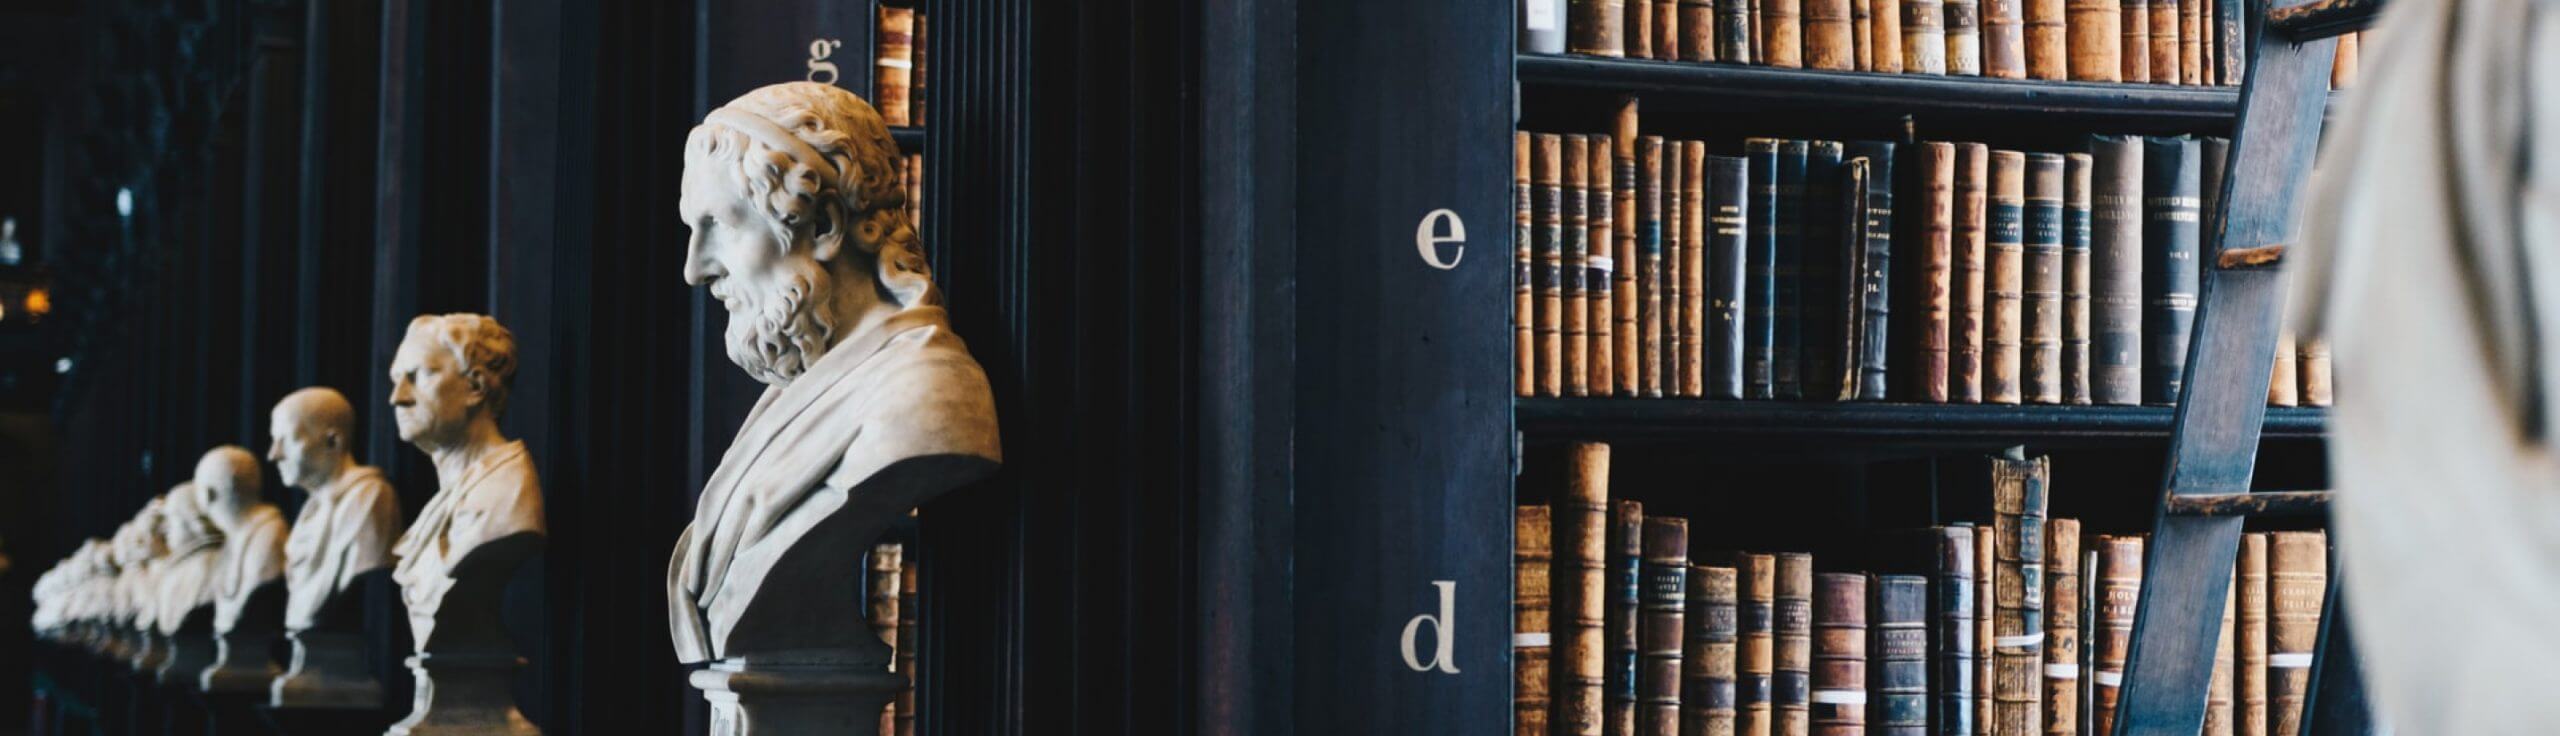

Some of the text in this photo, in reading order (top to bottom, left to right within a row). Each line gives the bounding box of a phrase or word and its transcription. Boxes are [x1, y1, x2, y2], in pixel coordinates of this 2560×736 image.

[808, 39, 841, 84] g
[1417, 208, 1466, 270] e
[1401, 580, 1461, 674] d
